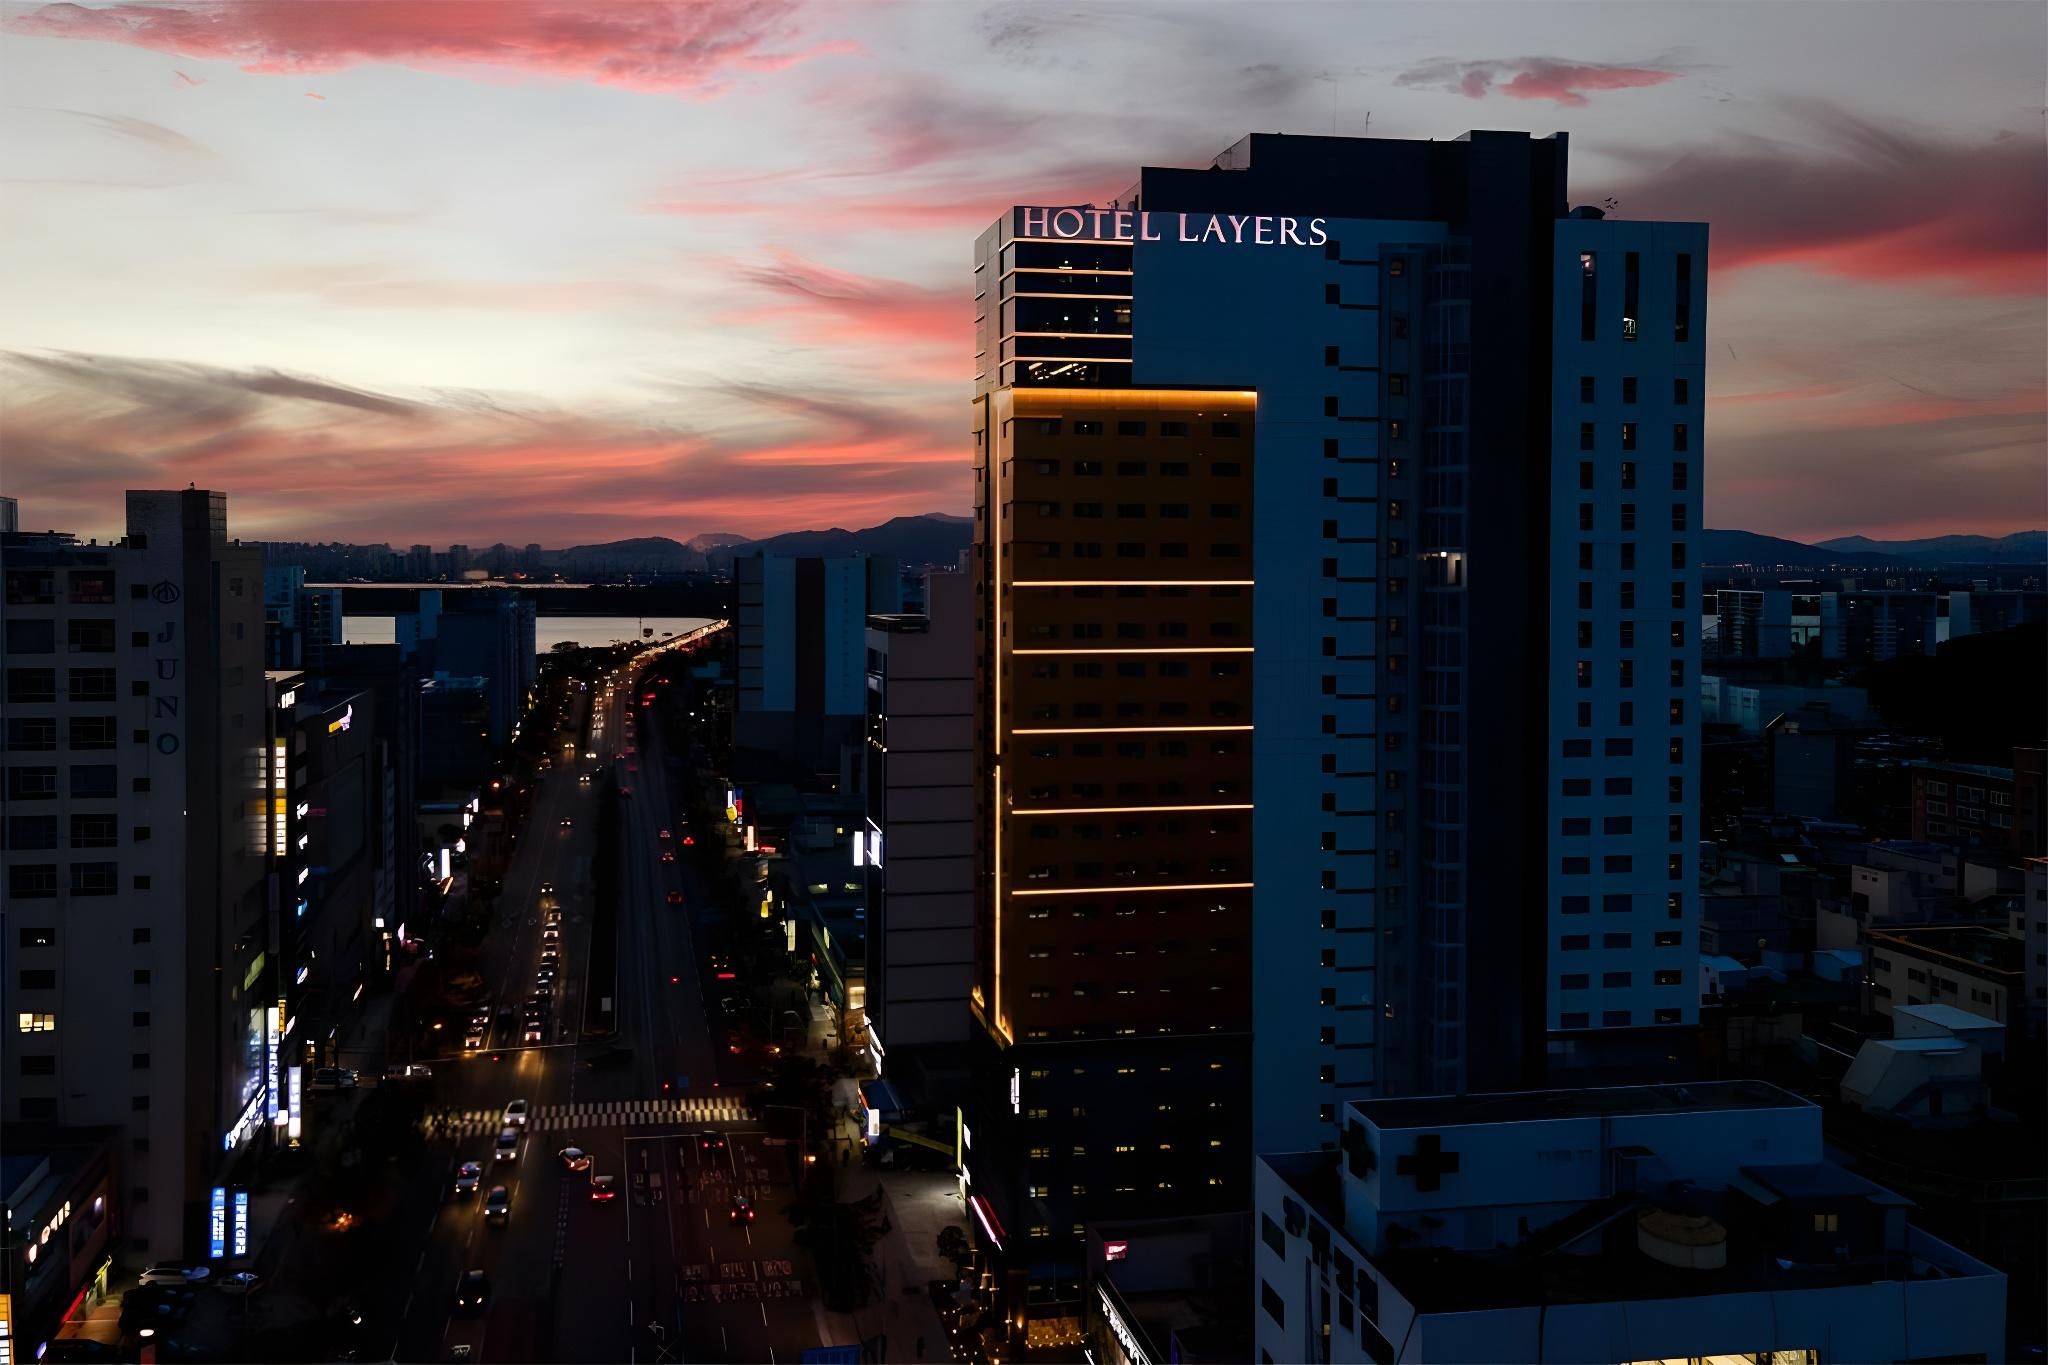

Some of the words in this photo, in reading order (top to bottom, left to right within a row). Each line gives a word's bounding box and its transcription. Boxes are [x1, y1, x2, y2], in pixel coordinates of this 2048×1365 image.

[1023, 207, 1160, 241] HOTEL
[1179, 213, 1327, 246] LAYERS
[154, 621, 180, 755] JUNO
